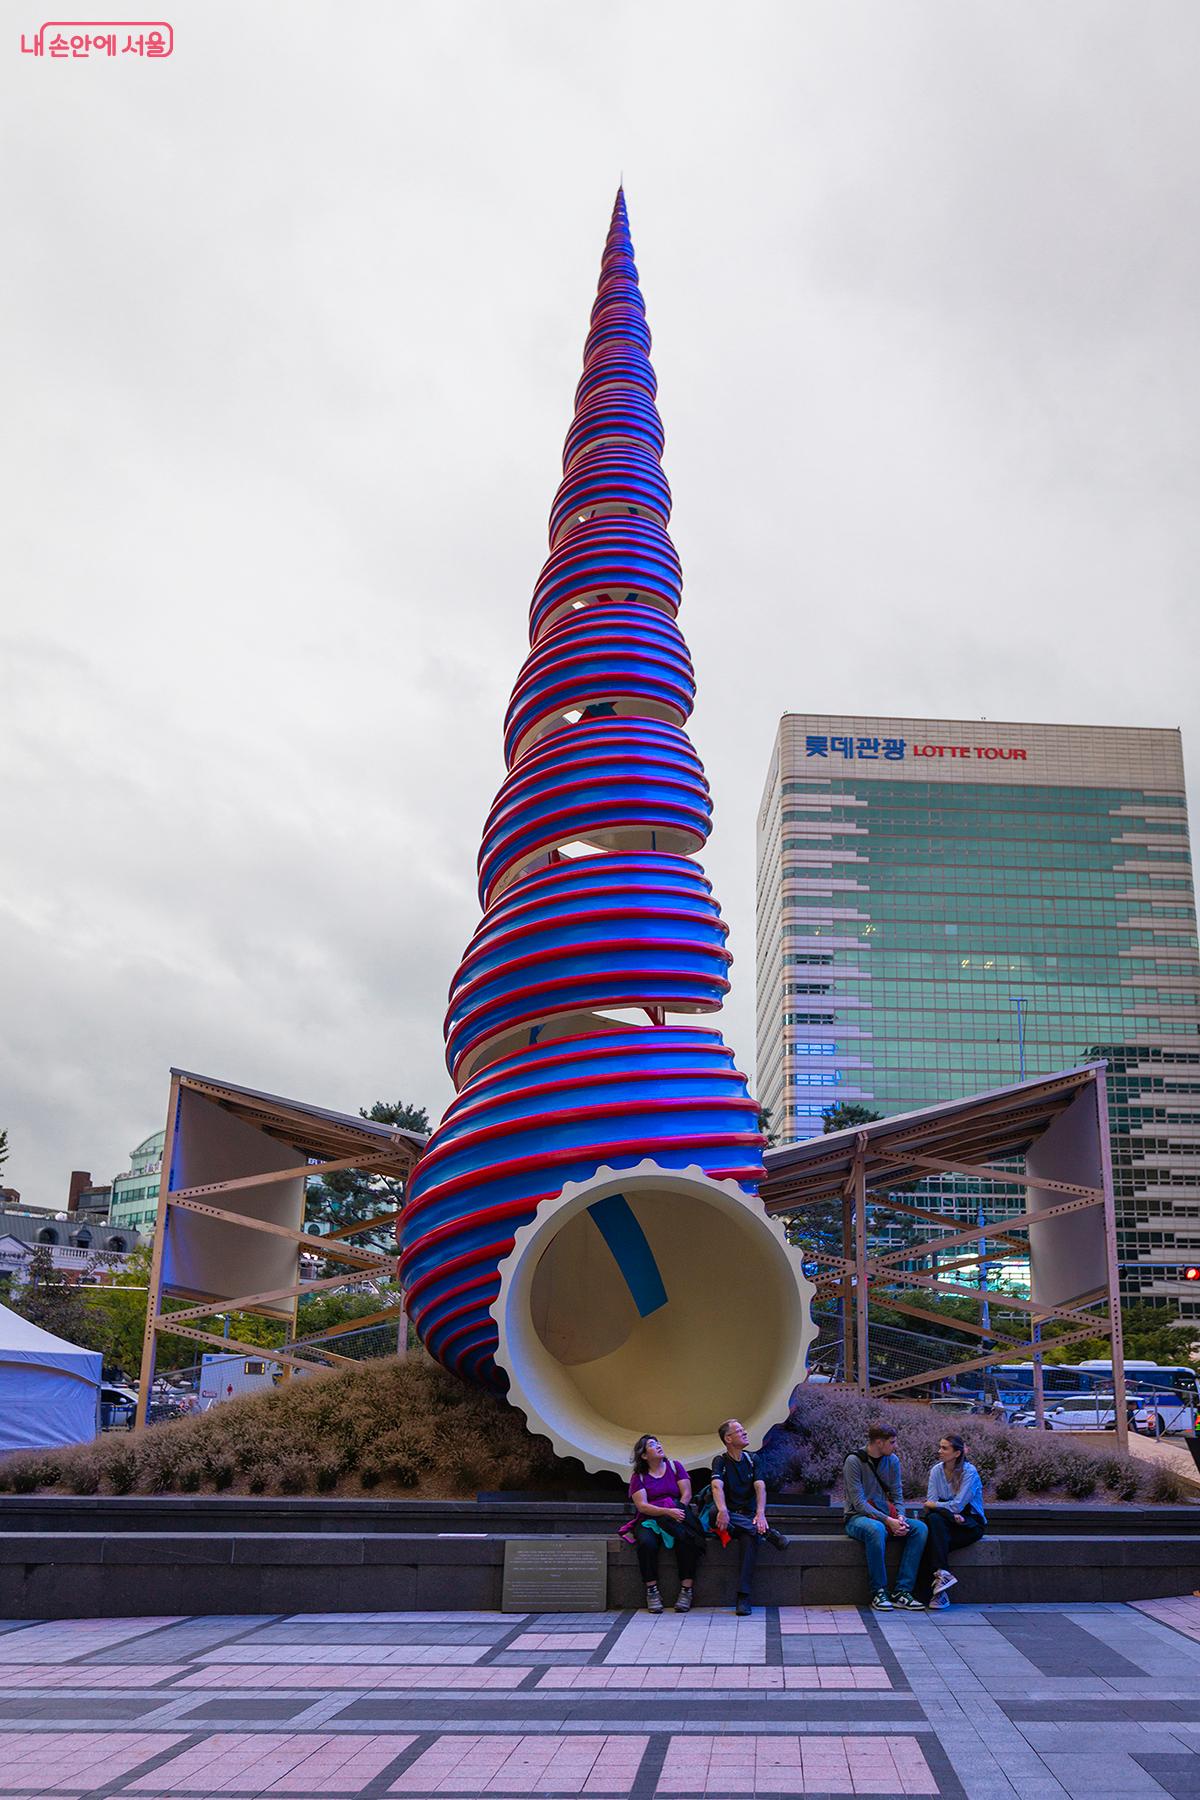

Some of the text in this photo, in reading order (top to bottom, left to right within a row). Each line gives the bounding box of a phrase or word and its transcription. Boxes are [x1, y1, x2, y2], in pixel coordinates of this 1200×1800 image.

[805, 735, 907, 760] 롯데관광
[913, 744, 1027, 761] LOTTE TOUR
